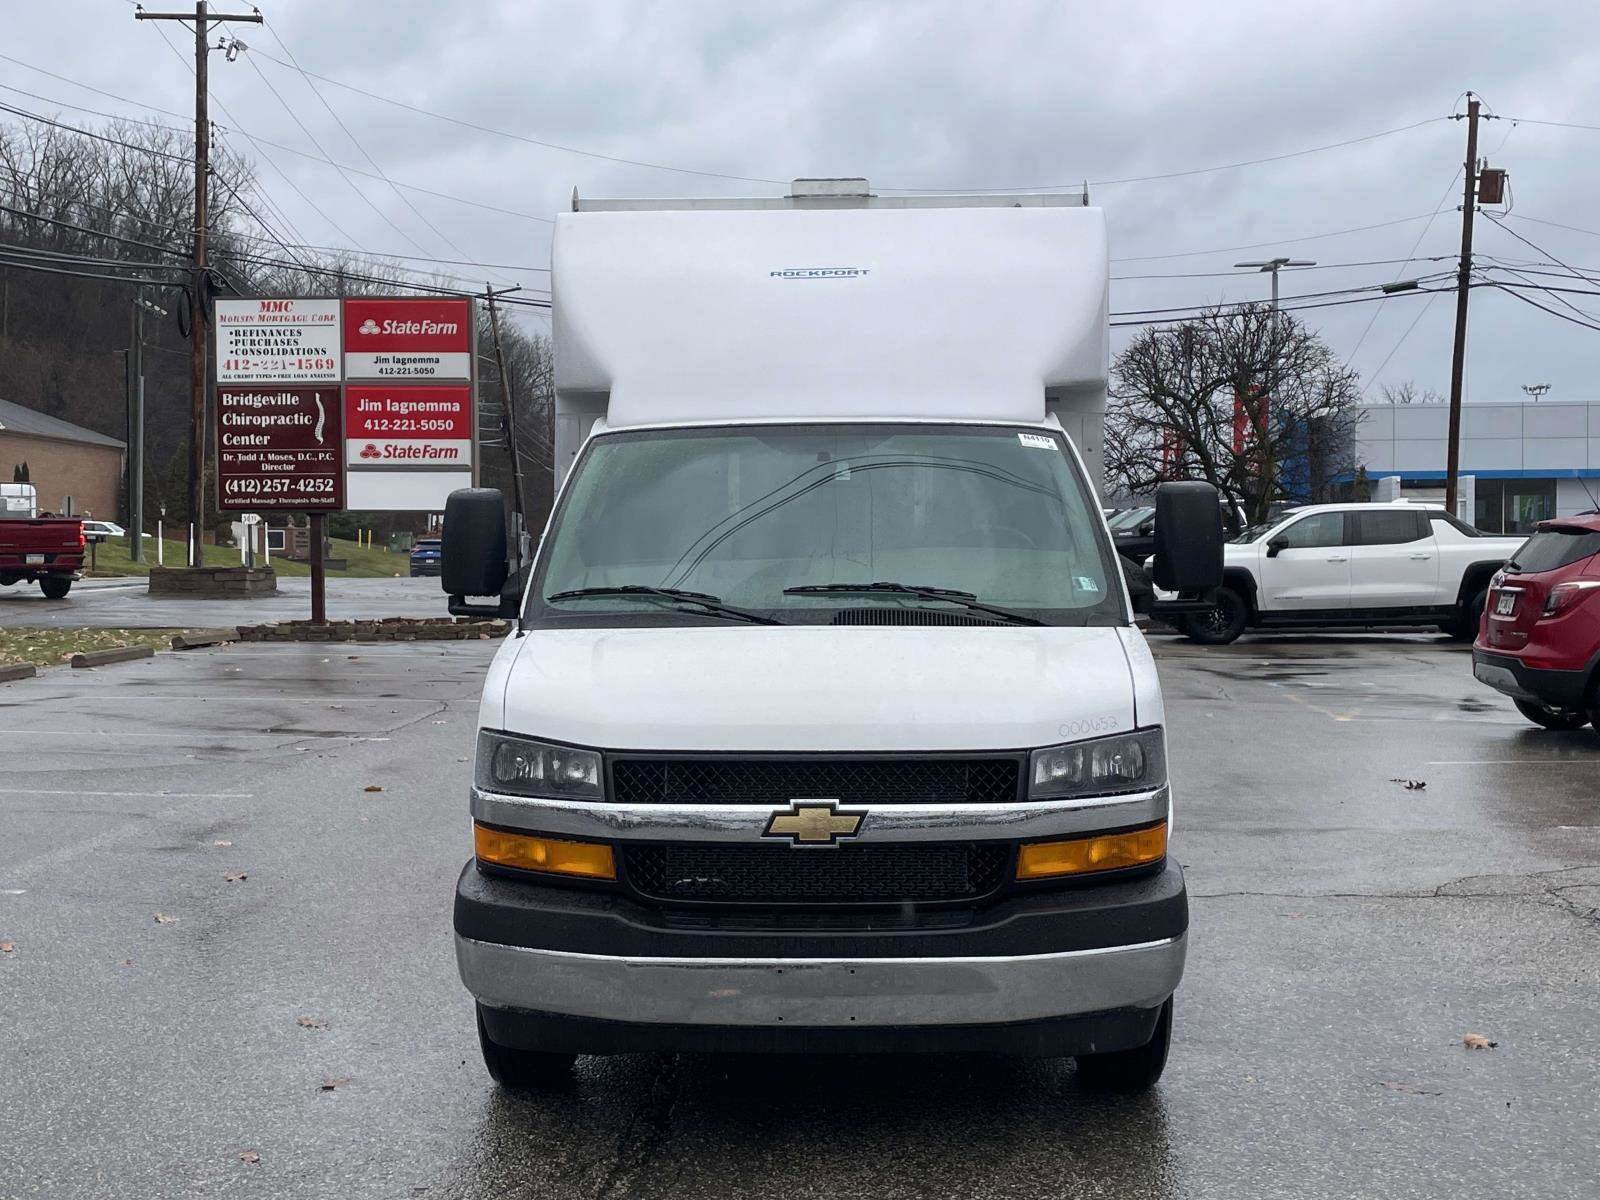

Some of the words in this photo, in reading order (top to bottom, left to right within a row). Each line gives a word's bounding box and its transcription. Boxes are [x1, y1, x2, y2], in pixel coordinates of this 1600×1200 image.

[770, 269, 870, 277] ROCKPORT
[259, 301, 294, 313] MMC
[234, 329, 302, 337] REFINANCES
[234, 338, 299, 347] PURCHASES
[234, 347, 327, 356] CONSOLIDATIONS
[222, 358, 334, 371] 412-221-1569
[373, 356, 390, 364] Jim
[378, 367, 435, 375] 412-221-5050
[222, 393, 300, 408] Bridgeville
[356, 399, 382, 412] Jim
[386, 399, 460, 414] Iagnemma
[222, 412, 313, 428] Chiropractic
[364, 419, 454, 431] 412-221-5050
[222, 433, 271, 446] Center
[223, 453, 236, 462] Dr.
[237, 453, 257, 461] Todd
[258, 453, 266, 461] J.
[267, 453, 296, 462] Moses,
[318, 452, 335, 461] P.C.
[261, 463, 296, 471] Director
[225, 479, 261, 495] (412)
[262, 478, 334, 492] 257-4252
